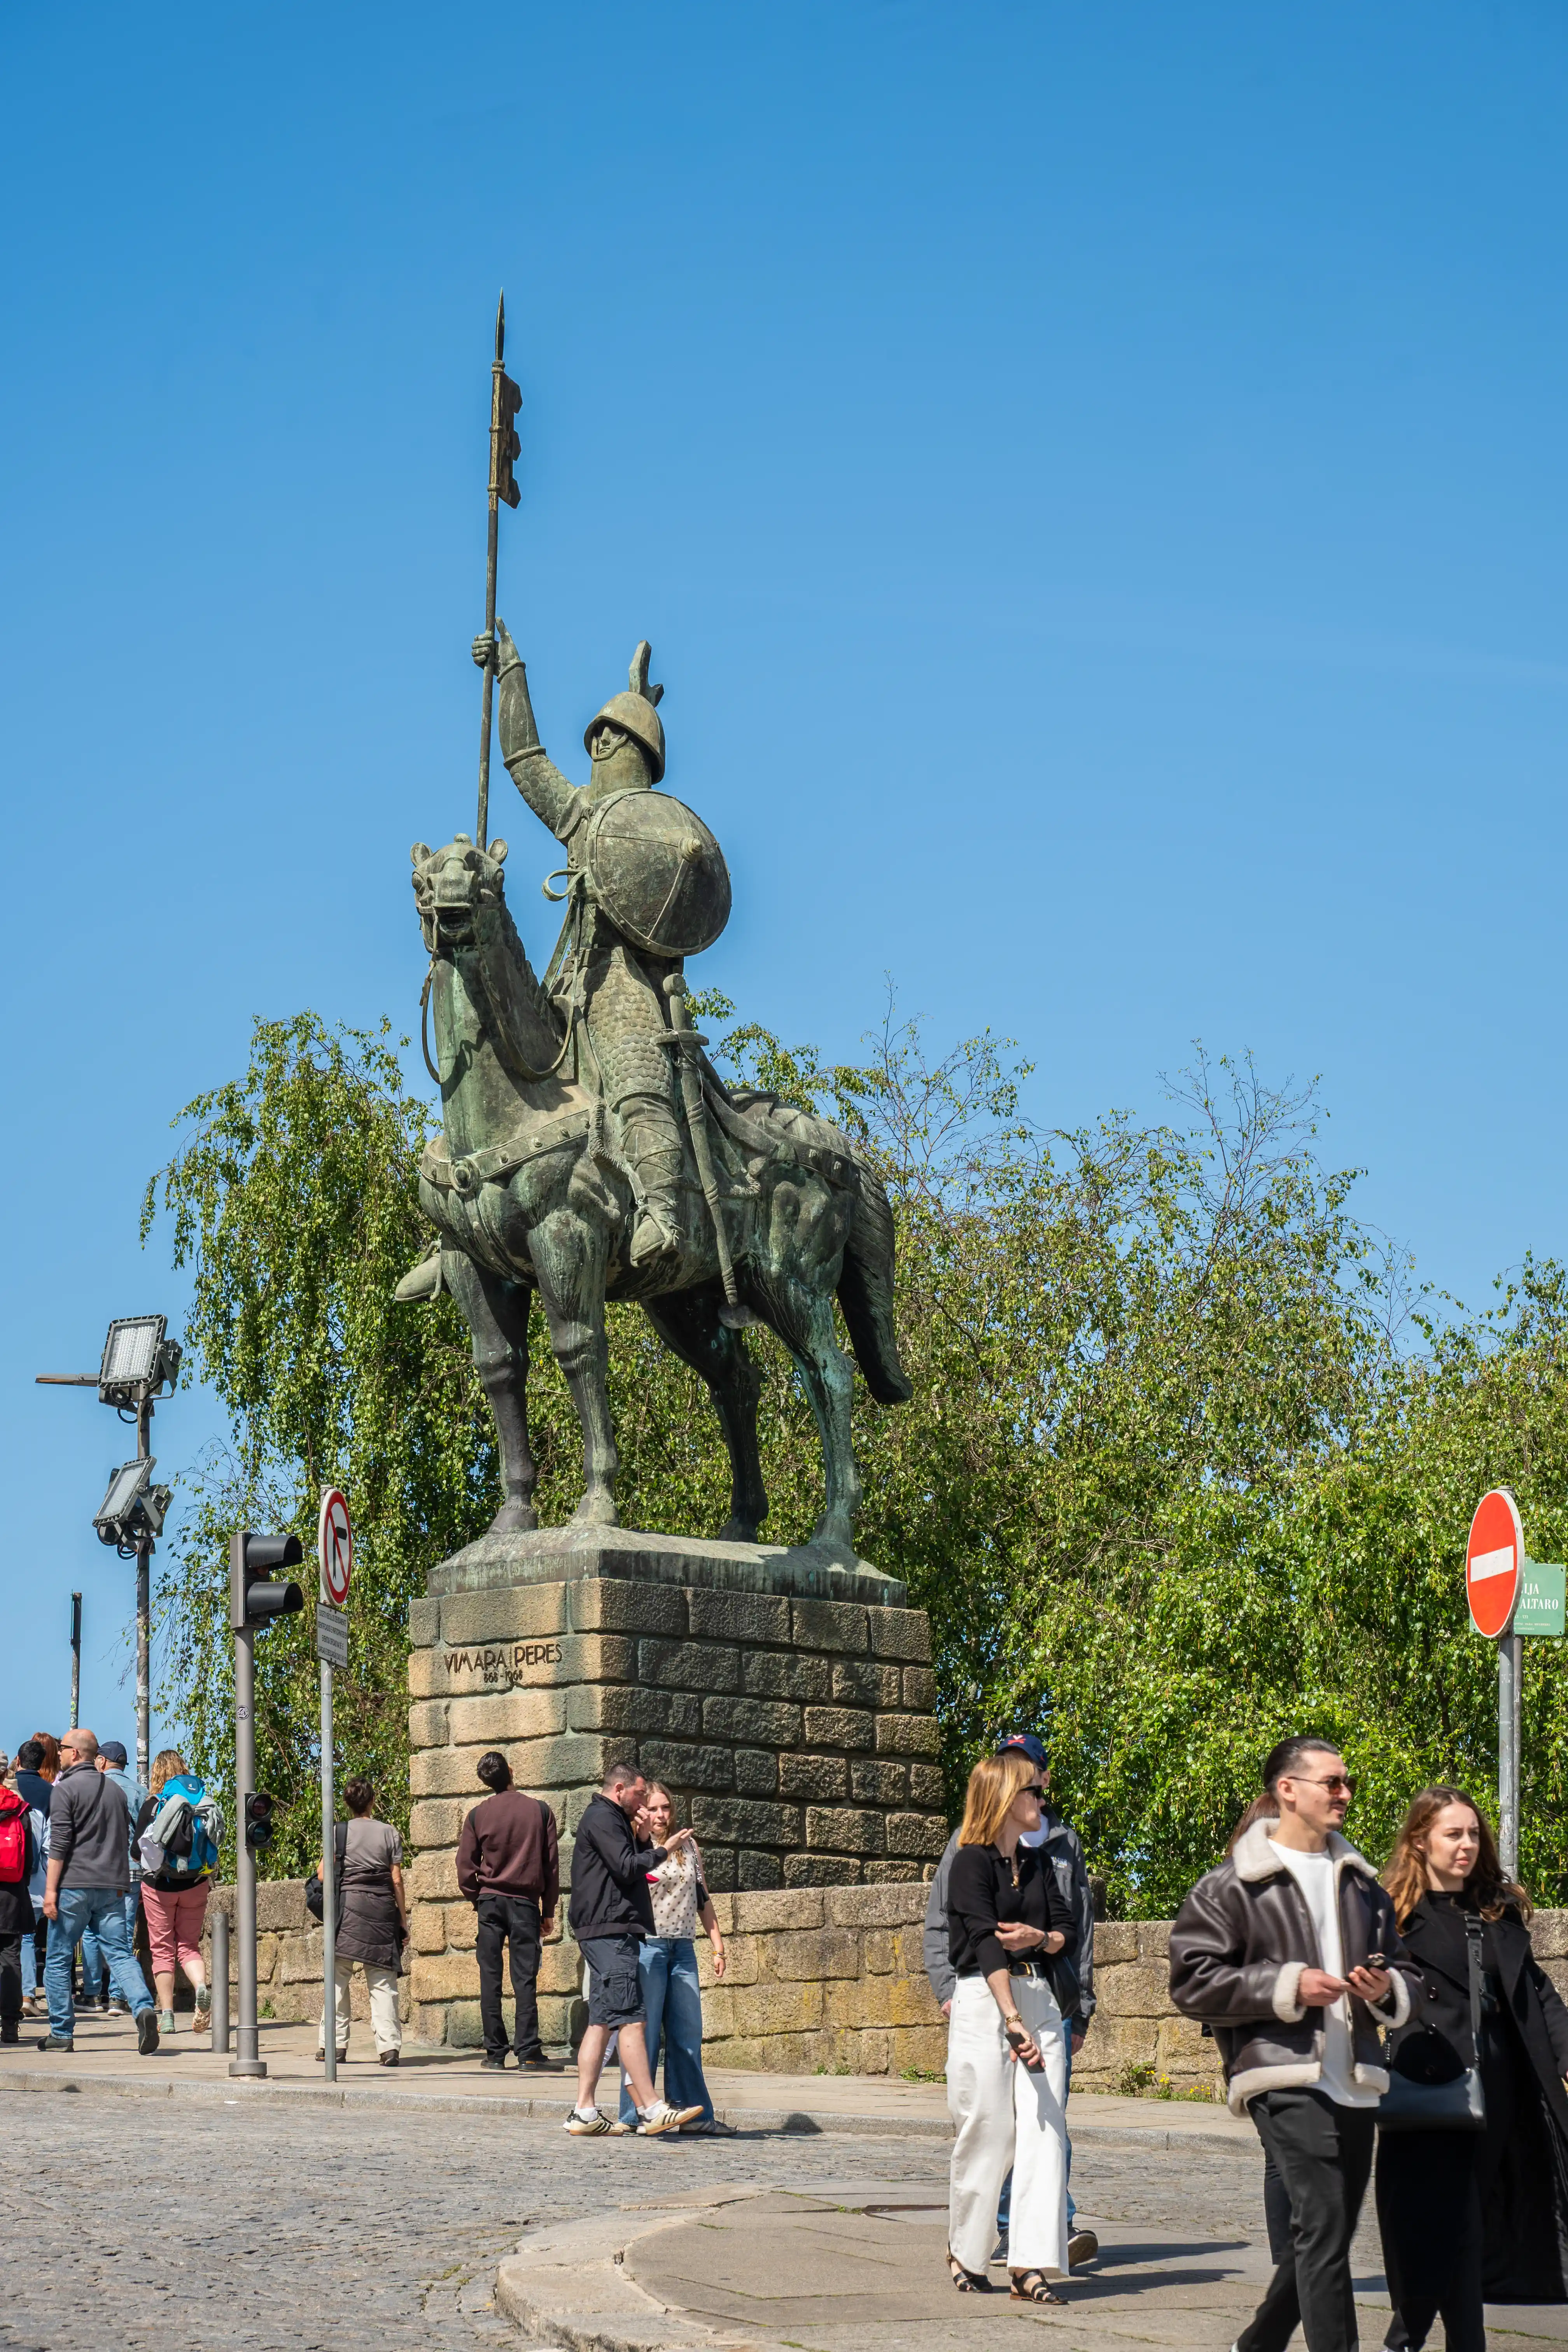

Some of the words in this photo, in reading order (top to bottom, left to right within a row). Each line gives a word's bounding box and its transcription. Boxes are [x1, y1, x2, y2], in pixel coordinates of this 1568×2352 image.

[1521, 1583, 1539, 1596] IJA
[443, 1649, 507, 1673] VIMARA
[514, 1643, 563, 1667] PERES
